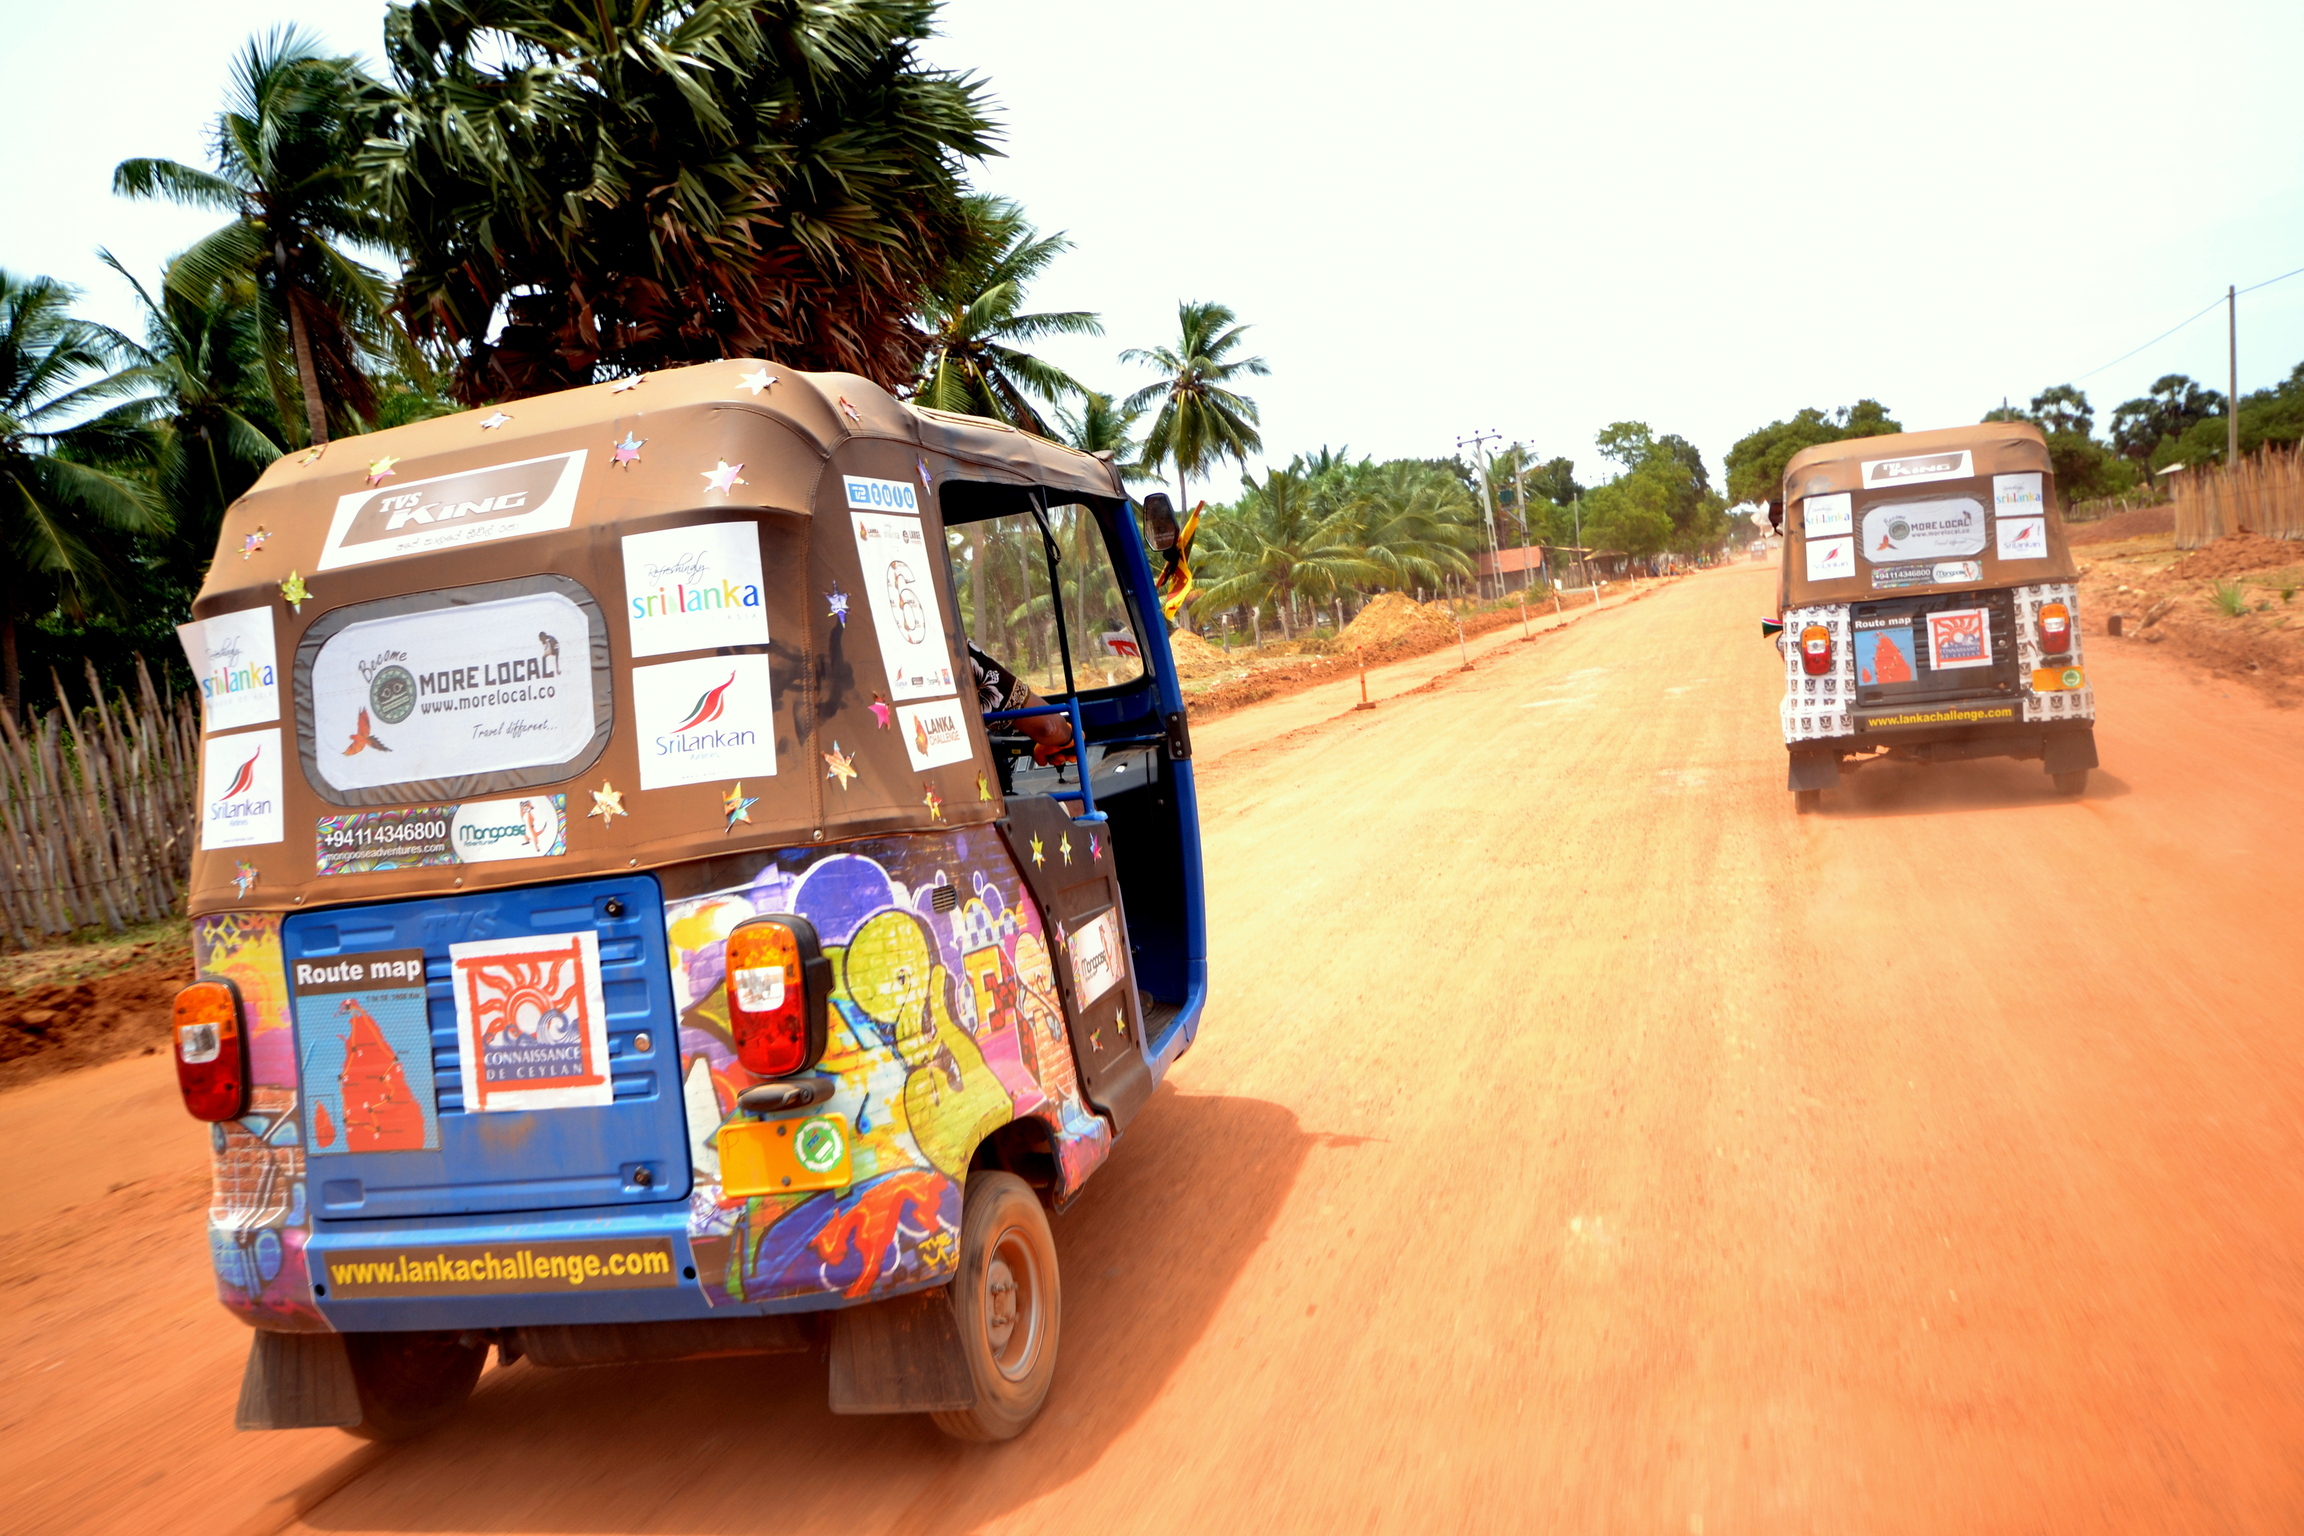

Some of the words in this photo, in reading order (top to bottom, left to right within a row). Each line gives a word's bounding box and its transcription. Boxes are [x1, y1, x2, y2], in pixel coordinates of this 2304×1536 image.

[379, 492, 423, 513] TVS
[385, 491, 529, 531] KING
[1911, 522, 1937, 532] MORE
[1939, 518, 1969, 529] LOCAL
[886, 560, 926, 645] 6
[1855, 619, 1886, 630] Route
[1888, 617, 1912, 627] map
[358, 650, 407, 684] Become
[419, 666, 479, 696] MORE
[484, 656, 554, 686] LOCAL
[421, 685, 556, 715] www.morelocal.co
[924, 716, 956, 735] LANKA
[1868, 708, 2013, 727] www.lankachallenge.com
[472, 719, 503, 740] Travel
[928, 731, 961, 746] CHALLENGE
[655, 729, 755, 756] SriLankan
[210, 799, 271, 821] SriLankan
[459, 824, 526, 842] Mongoose
[326, 843, 445, 862] mongooseadventures.com
[296, 961, 364, 986] Route
[370, 959, 421, 982] map
[484, 1046, 580, 1066] CONNAISSANCE
[486, 1067, 506, 1080] DE
[516, 1063, 582, 1079] CEYLAN
[331, 1250, 670, 1285] www.lankachallenge.com
